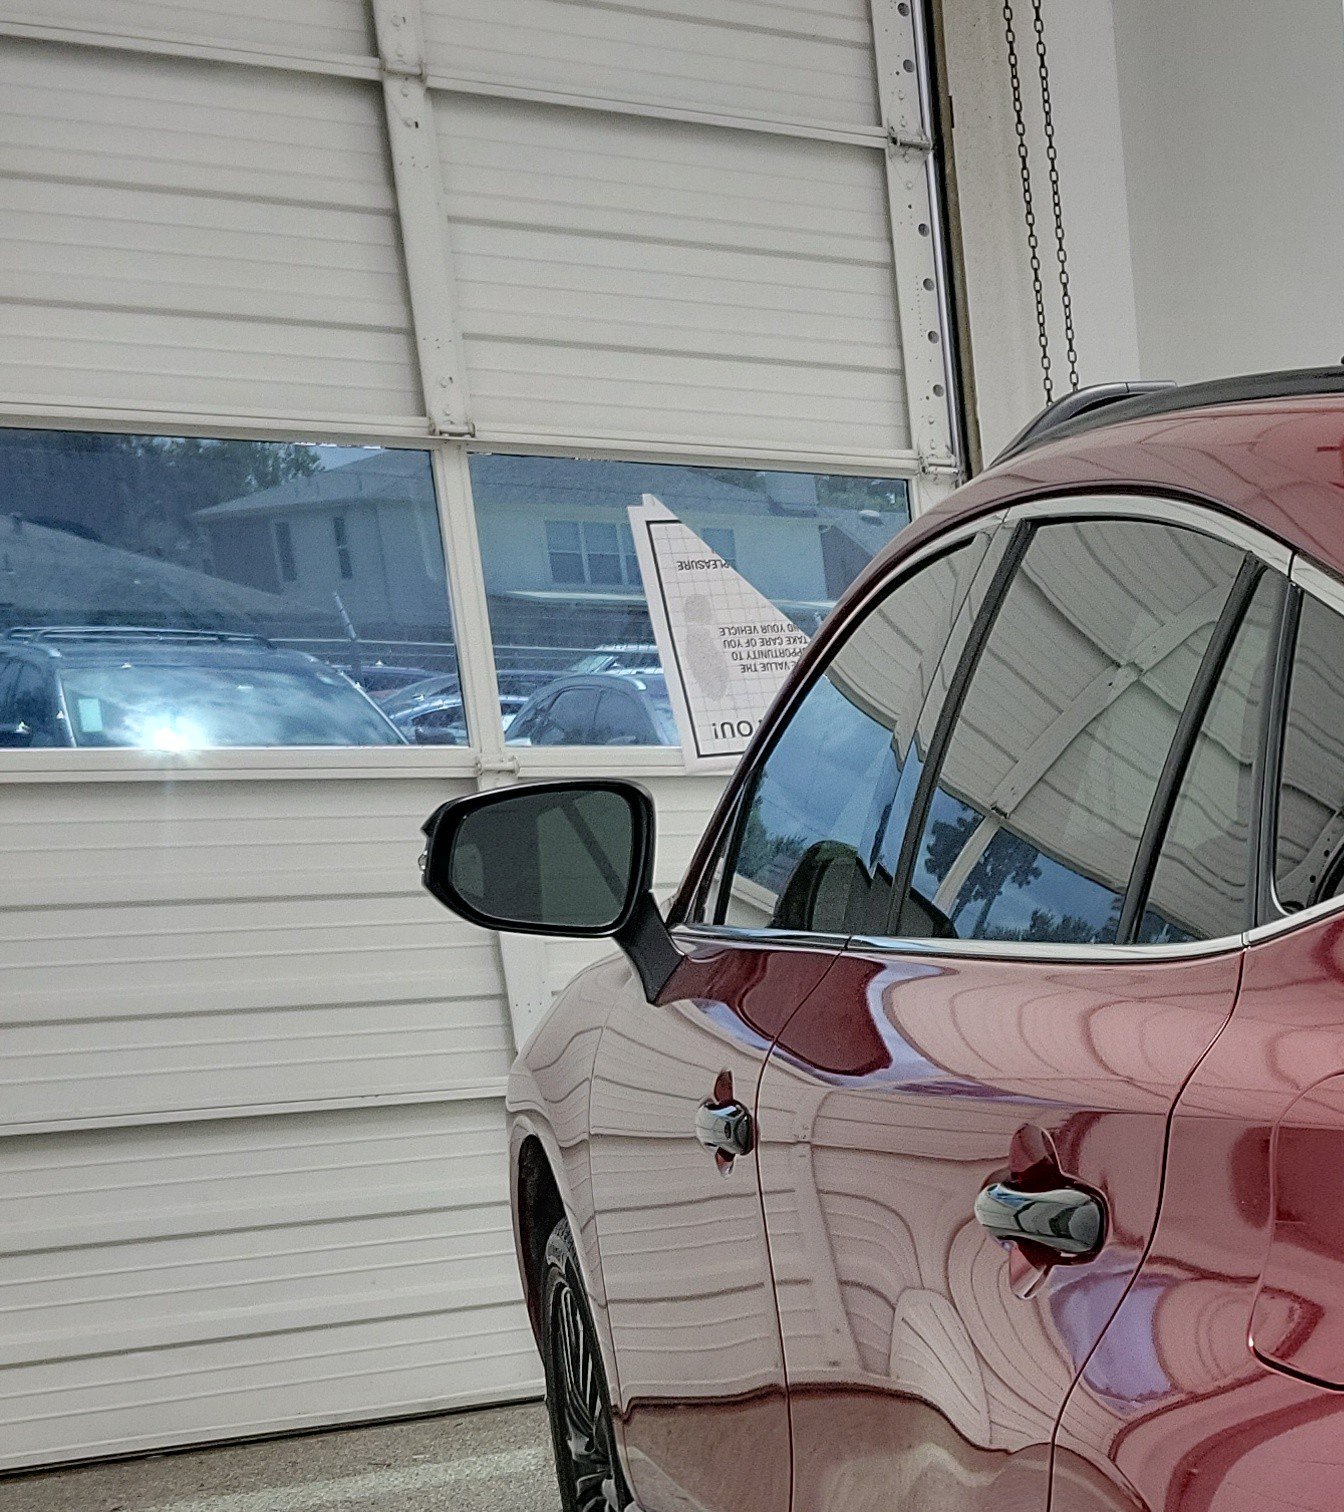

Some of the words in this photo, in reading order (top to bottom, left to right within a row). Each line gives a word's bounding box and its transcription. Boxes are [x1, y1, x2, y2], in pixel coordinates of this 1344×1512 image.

[719, 625, 759, 636] VEHICLE
[760, 624, 784, 634] YOUR
[723, 639, 741, 649] YOU
[745, 638, 757, 648] OF
[760, 637, 783, 647] CARE
[786, 635, 807, 645] TAKE
[731, 651, 745, 661] TO
[740, 663, 758, 673] THE
[760, 661, 790, 672] VALUE
[712, 719, 763, 739] OU!
